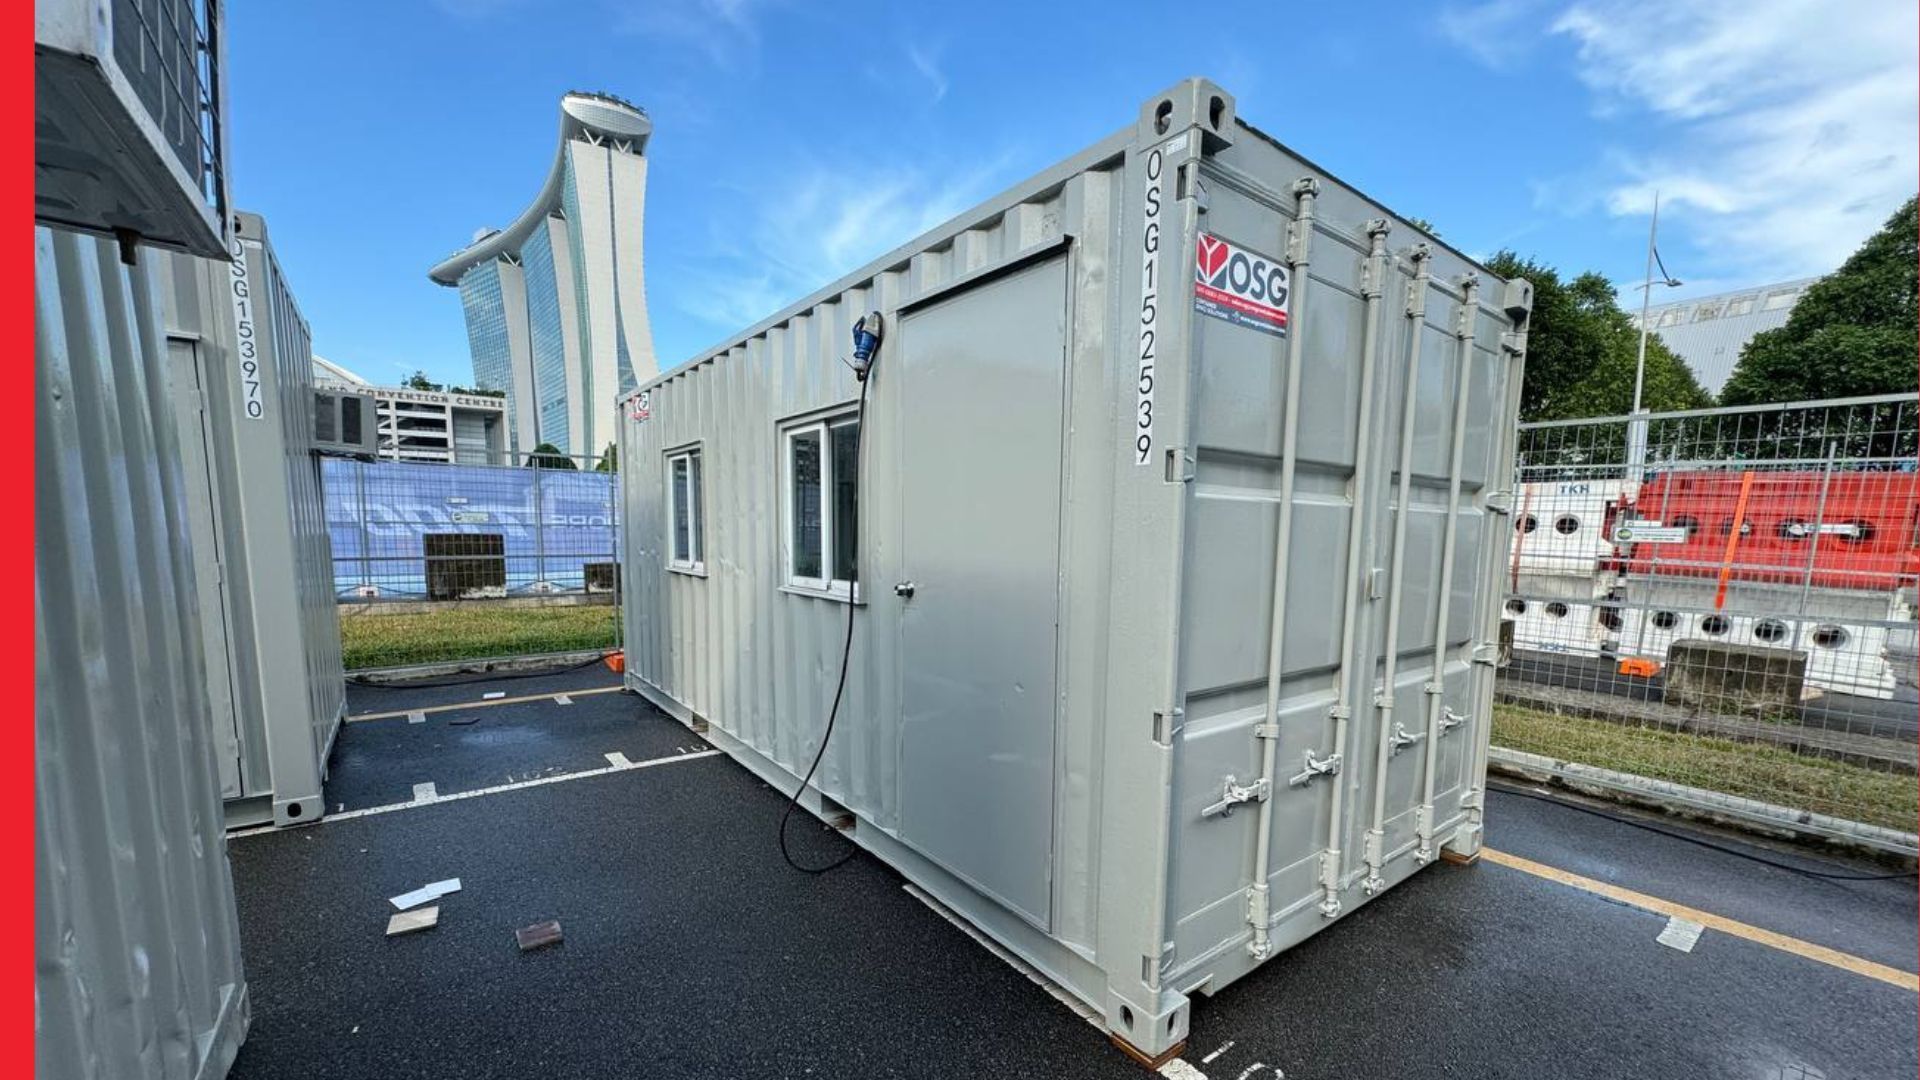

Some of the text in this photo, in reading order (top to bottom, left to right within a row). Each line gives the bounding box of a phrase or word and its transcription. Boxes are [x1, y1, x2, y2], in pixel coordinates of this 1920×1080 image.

[1228, 252, 1288, 307] OSG
[1137, 150, 1162, 463] OSG152539
[456, 397, 504, 408] CENTRE
[1560, 484, 1589, 494] TKH
